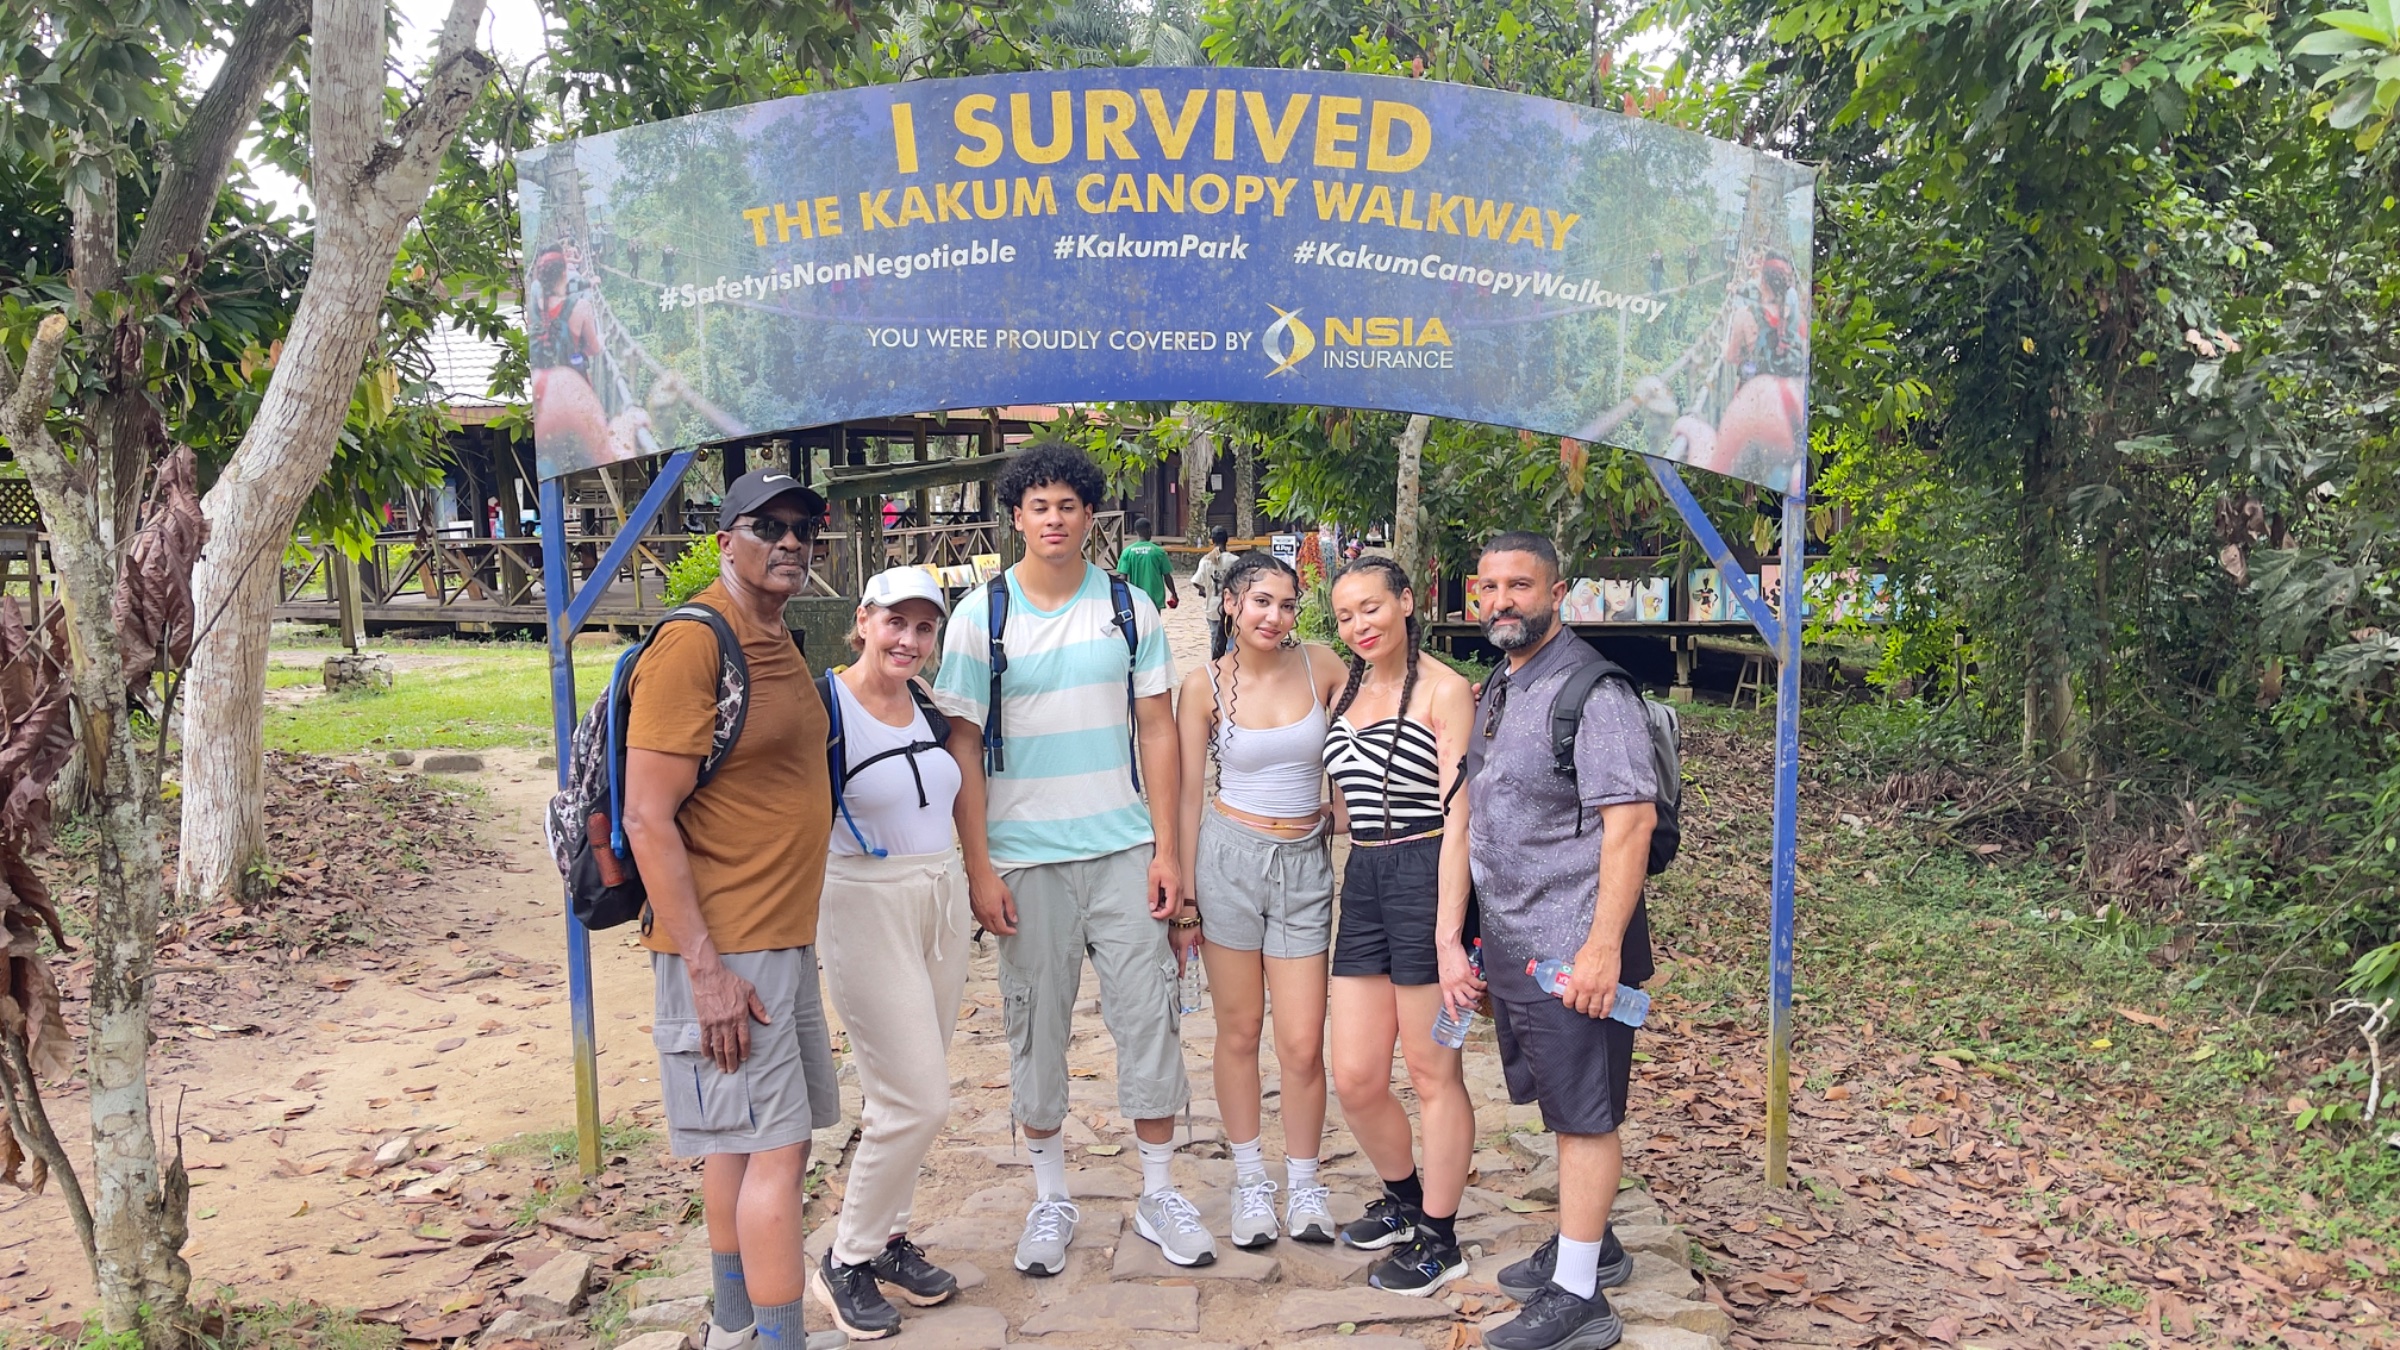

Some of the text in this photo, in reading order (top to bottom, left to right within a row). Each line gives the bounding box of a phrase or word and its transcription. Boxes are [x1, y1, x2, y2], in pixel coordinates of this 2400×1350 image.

[891, 90, 1432, 174] I SURVIVED
[743, 173, 1580, 251] THE KAKUM CANOPY WALKWAY
[659, 233, 1668, 323] #SafetyisNonNegotiable #KakumPark #KakumCanopyWalkway
[867, 328, 1253, 350] YOU WERE PROUDLY COVERED BY
[1324, 317, 1453, 347] NSIA
[1323, 350, 1454, 369] INSURANCE
